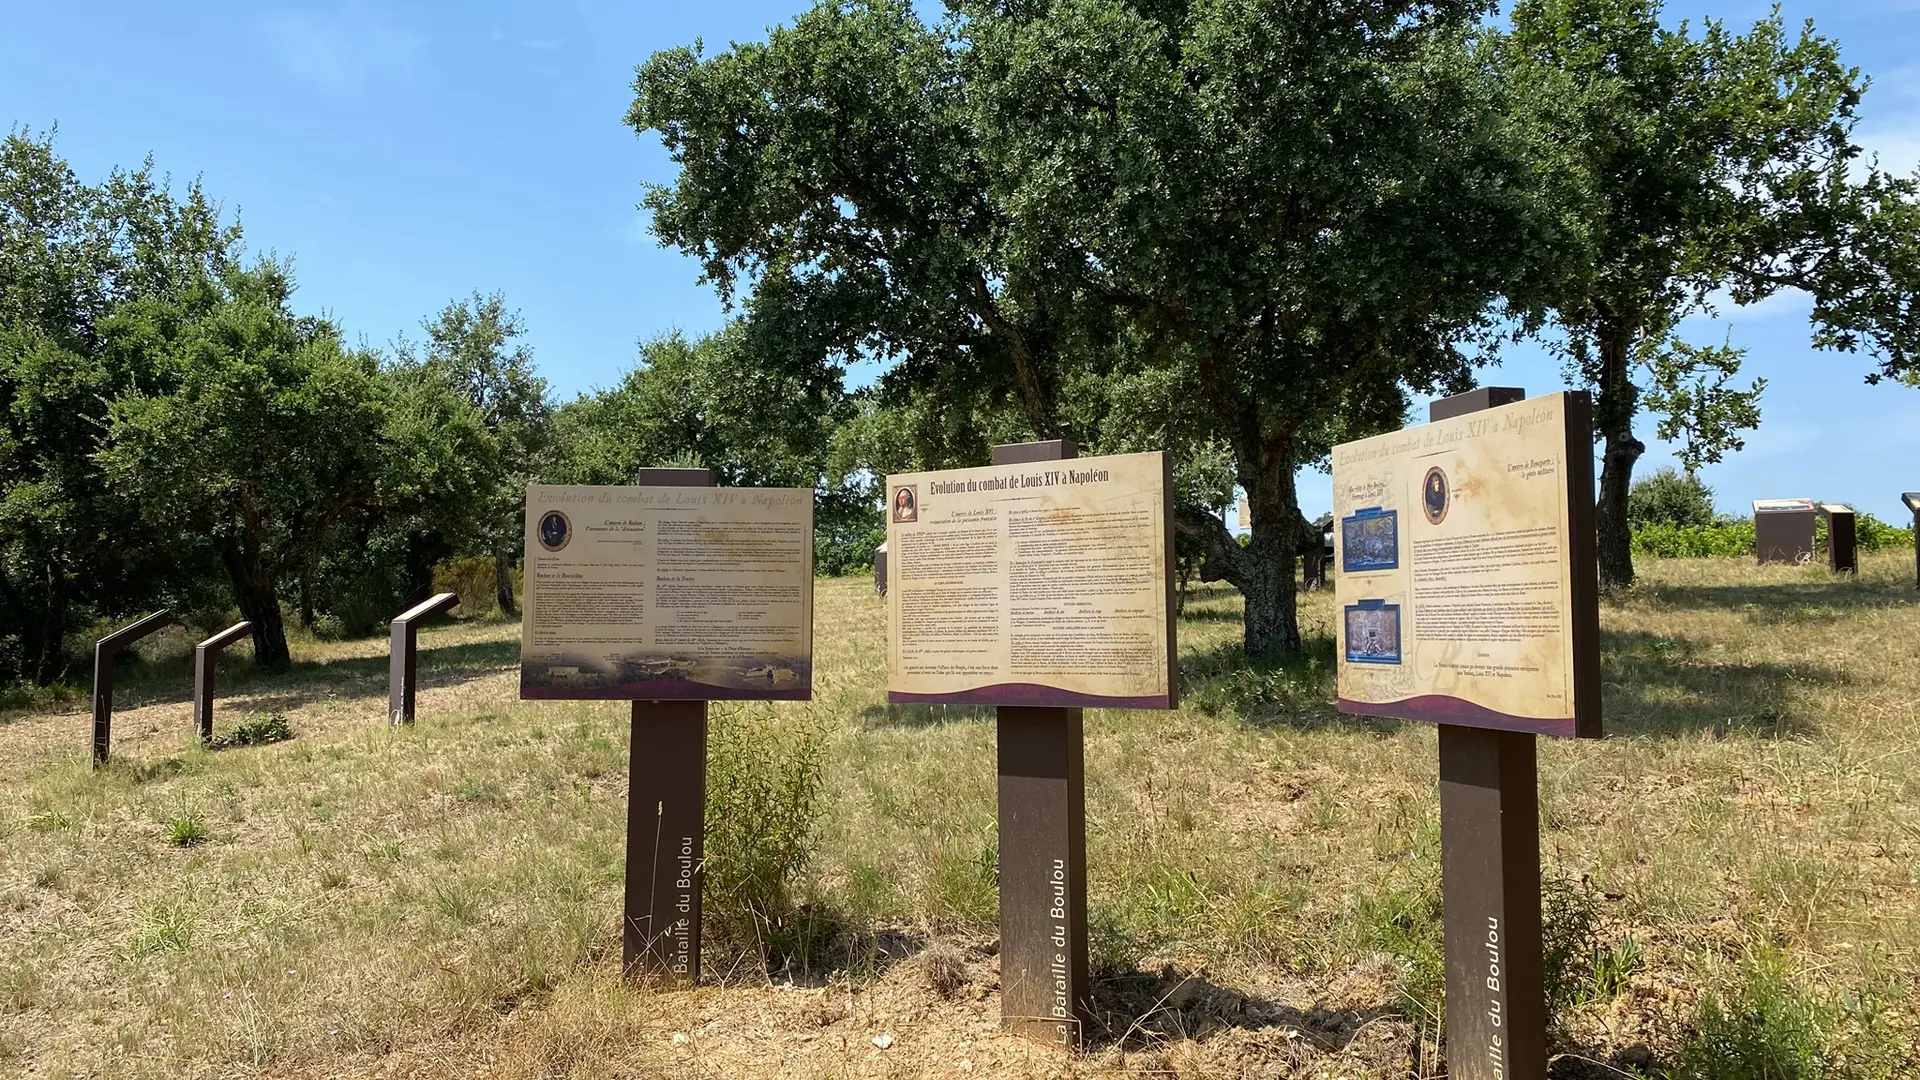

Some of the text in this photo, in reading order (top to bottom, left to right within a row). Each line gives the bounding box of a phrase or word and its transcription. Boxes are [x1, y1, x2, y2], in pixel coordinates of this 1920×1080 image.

[1379, 442, 1389, 457] du
[1392, 436, 1420, 455] combat
[1423, 431, 1434, 448] de
[1436, 428, 1463, 445] Louis
[1467, 418, 1490, 439] XIV
[538, 491, 594, 503] Evolution
[598, 492, 612, 503] du
[616, 492, 654, 504] combat
[658, 492, 671, 504] de
[676, 492, 707, 504] Louis
[712, 493, 738, 504] XIV
[930, 468, 1109, 496] Evolution du combat de Louis XIV à Napoléon
[674, 837, 693, 973] Bataille du Boulou
[1050, 859, 1067, 1045] La Bataille du Boulou
[1485, 916, 1503, 1080] aille du Boulou
